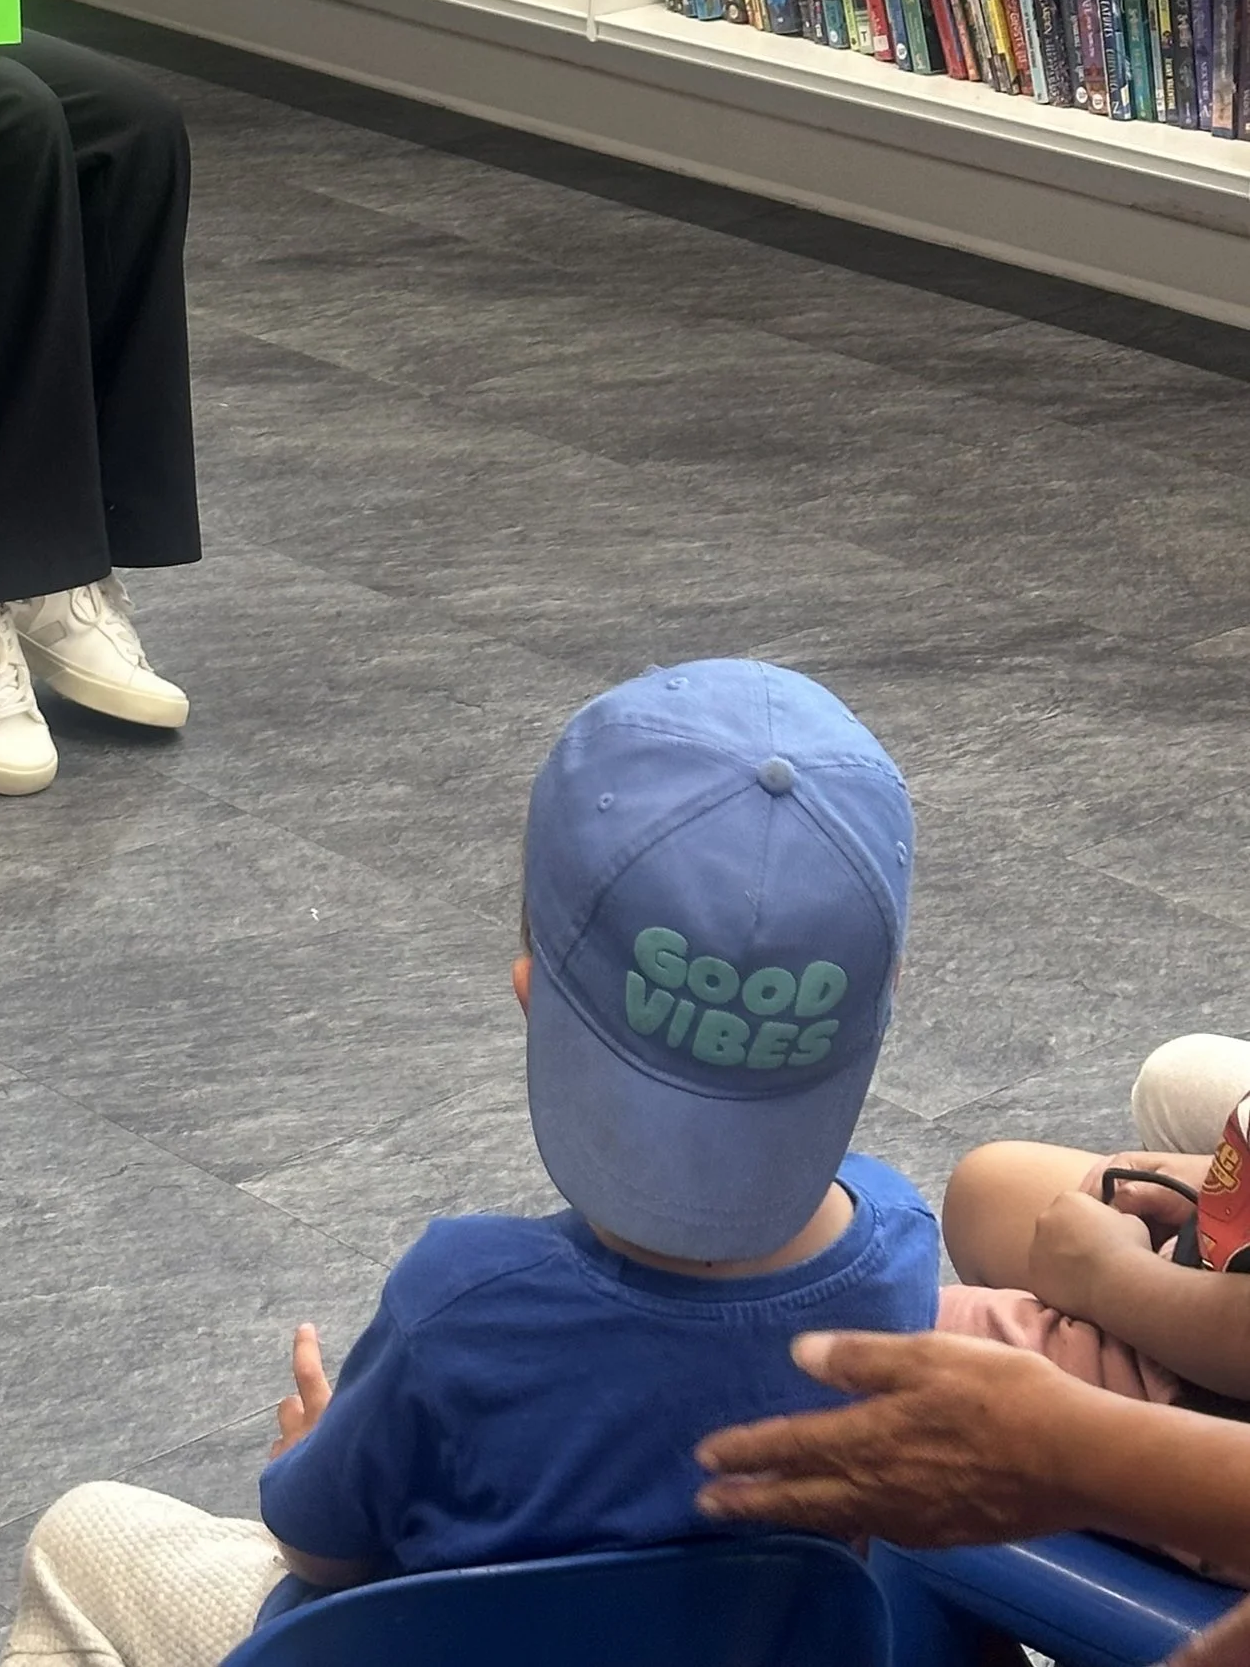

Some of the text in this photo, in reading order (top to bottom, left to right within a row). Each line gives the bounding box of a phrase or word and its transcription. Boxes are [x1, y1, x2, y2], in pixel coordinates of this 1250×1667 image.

[860, 31, 868, 41] T
[634, 926, 848, 1017] GOOD
[625, 969, 840, 1069] VIBES
